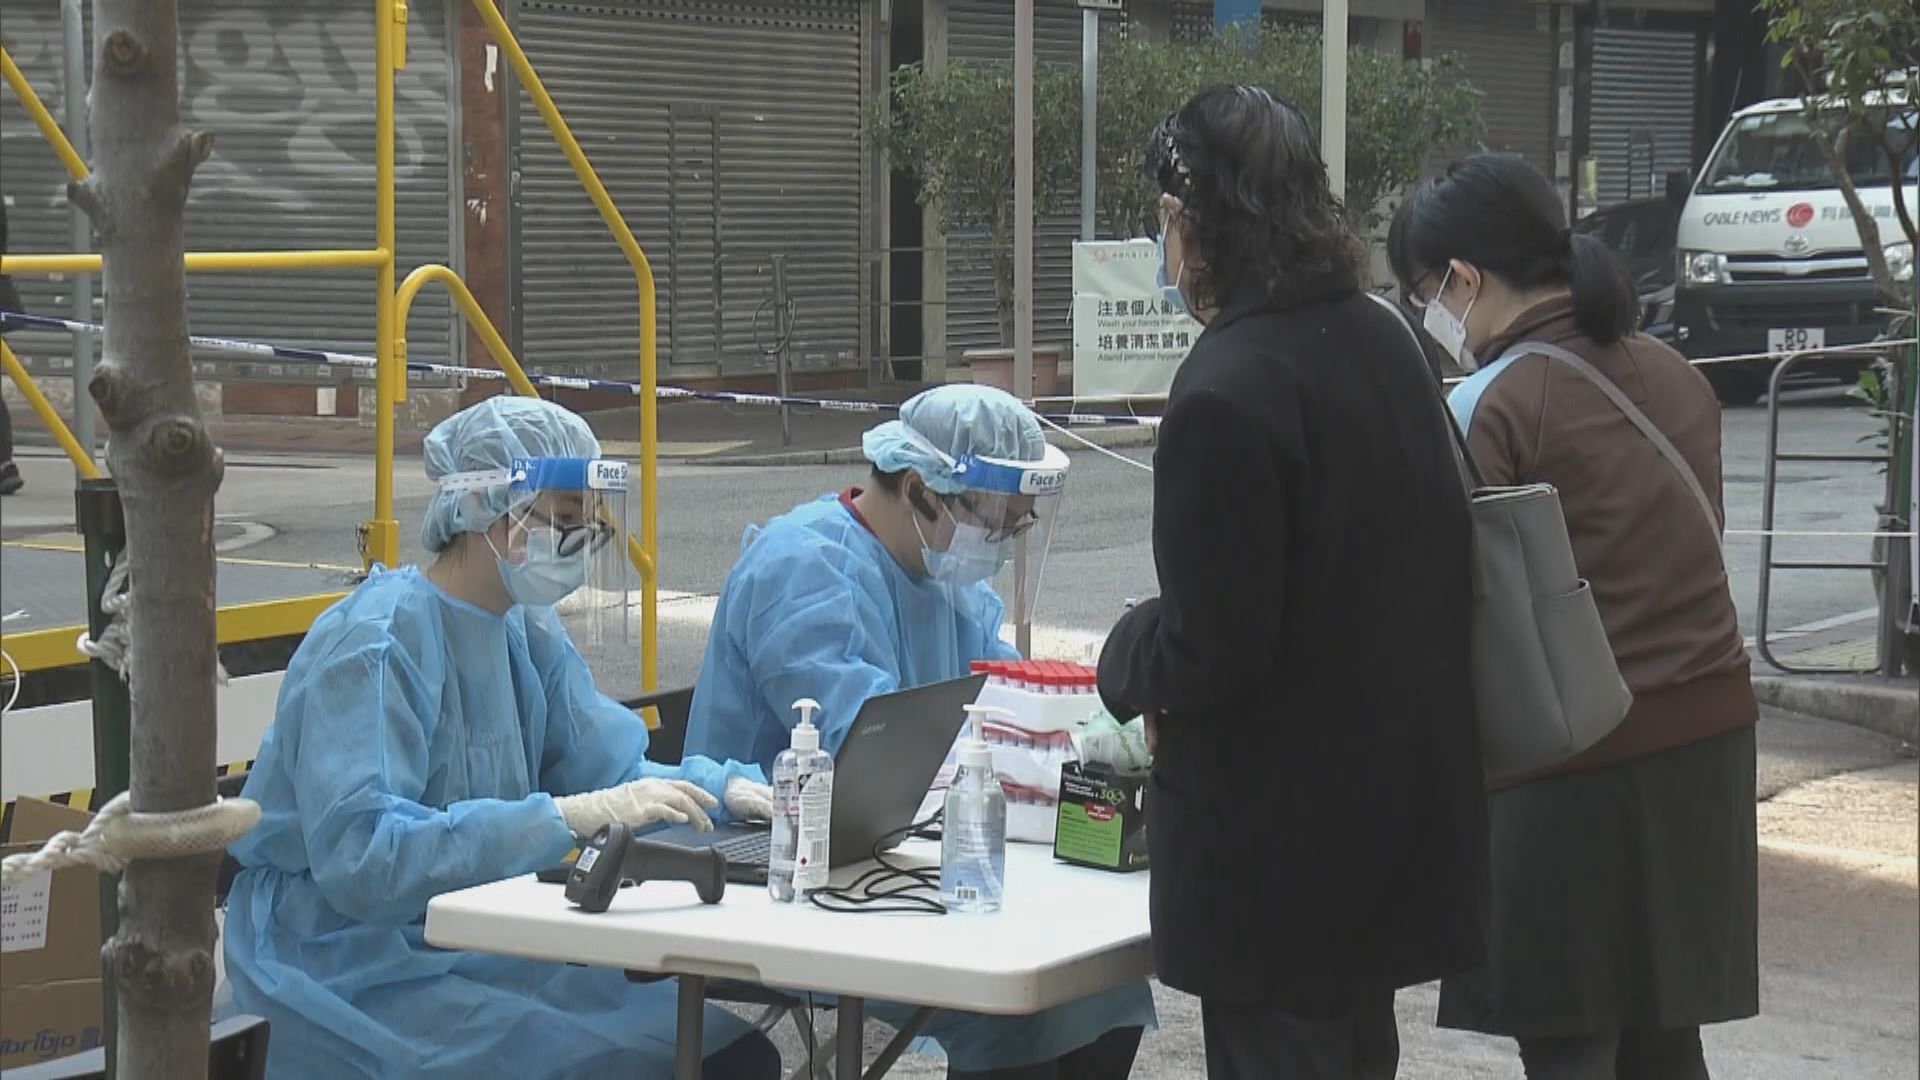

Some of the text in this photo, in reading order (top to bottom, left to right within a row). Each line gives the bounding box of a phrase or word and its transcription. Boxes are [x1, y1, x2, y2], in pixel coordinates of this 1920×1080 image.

[1704, 208, 1781, 226] CABLE NEWS
[1098, 300, 1186, 317] 注意個人衛
[1098, 319, 1120, 328] Wash
[1785, 329, 1808, 345] RD
[1097, 352, 1122, 361] Attend
[1124, 352, 1155, 362] personal
[597, 464, 619, 479] Face
[1030, 472, 1055, 486] Face
